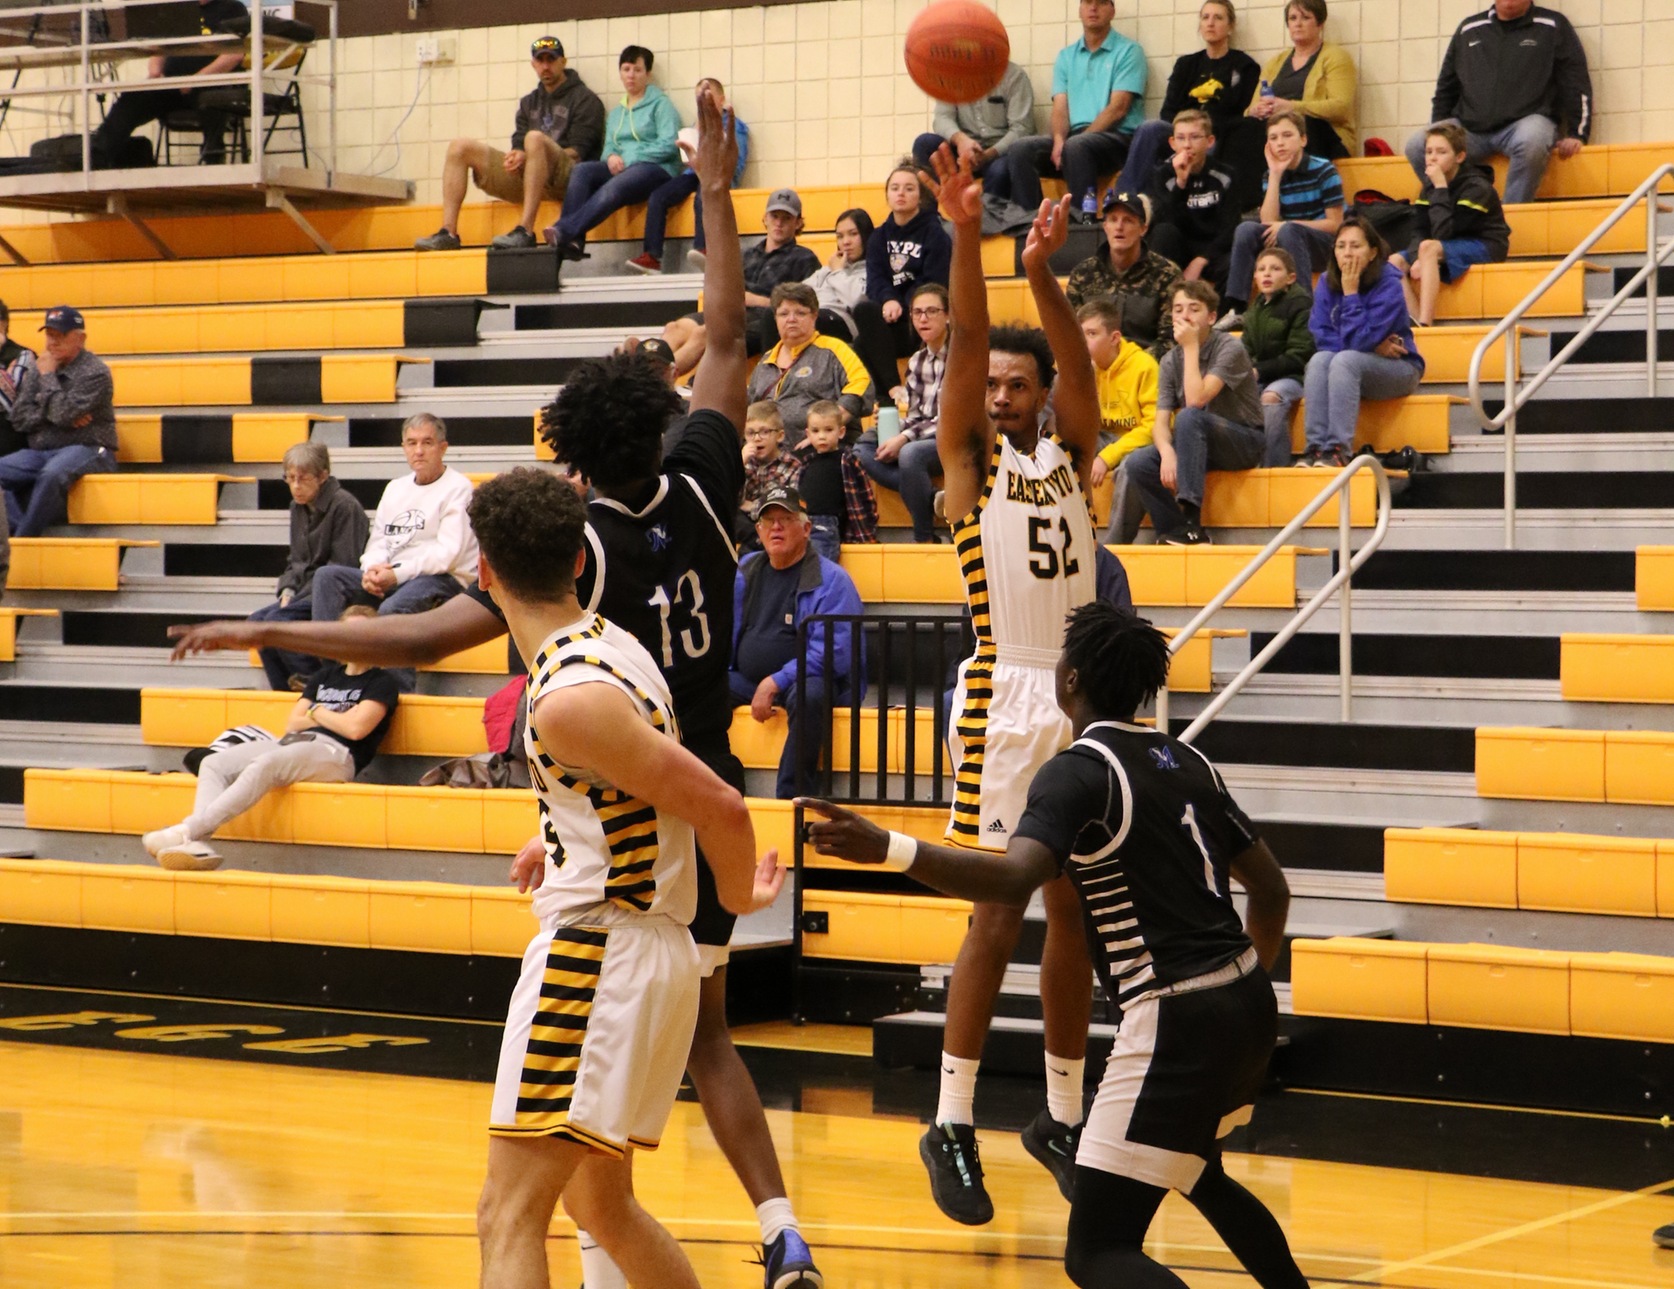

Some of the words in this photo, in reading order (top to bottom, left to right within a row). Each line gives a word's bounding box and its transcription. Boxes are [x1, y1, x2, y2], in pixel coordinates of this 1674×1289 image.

[1028, 516, 1080, 579] 52
[647, 568, 711, 668] 13
[1180, 803, 1222, 898] 1
